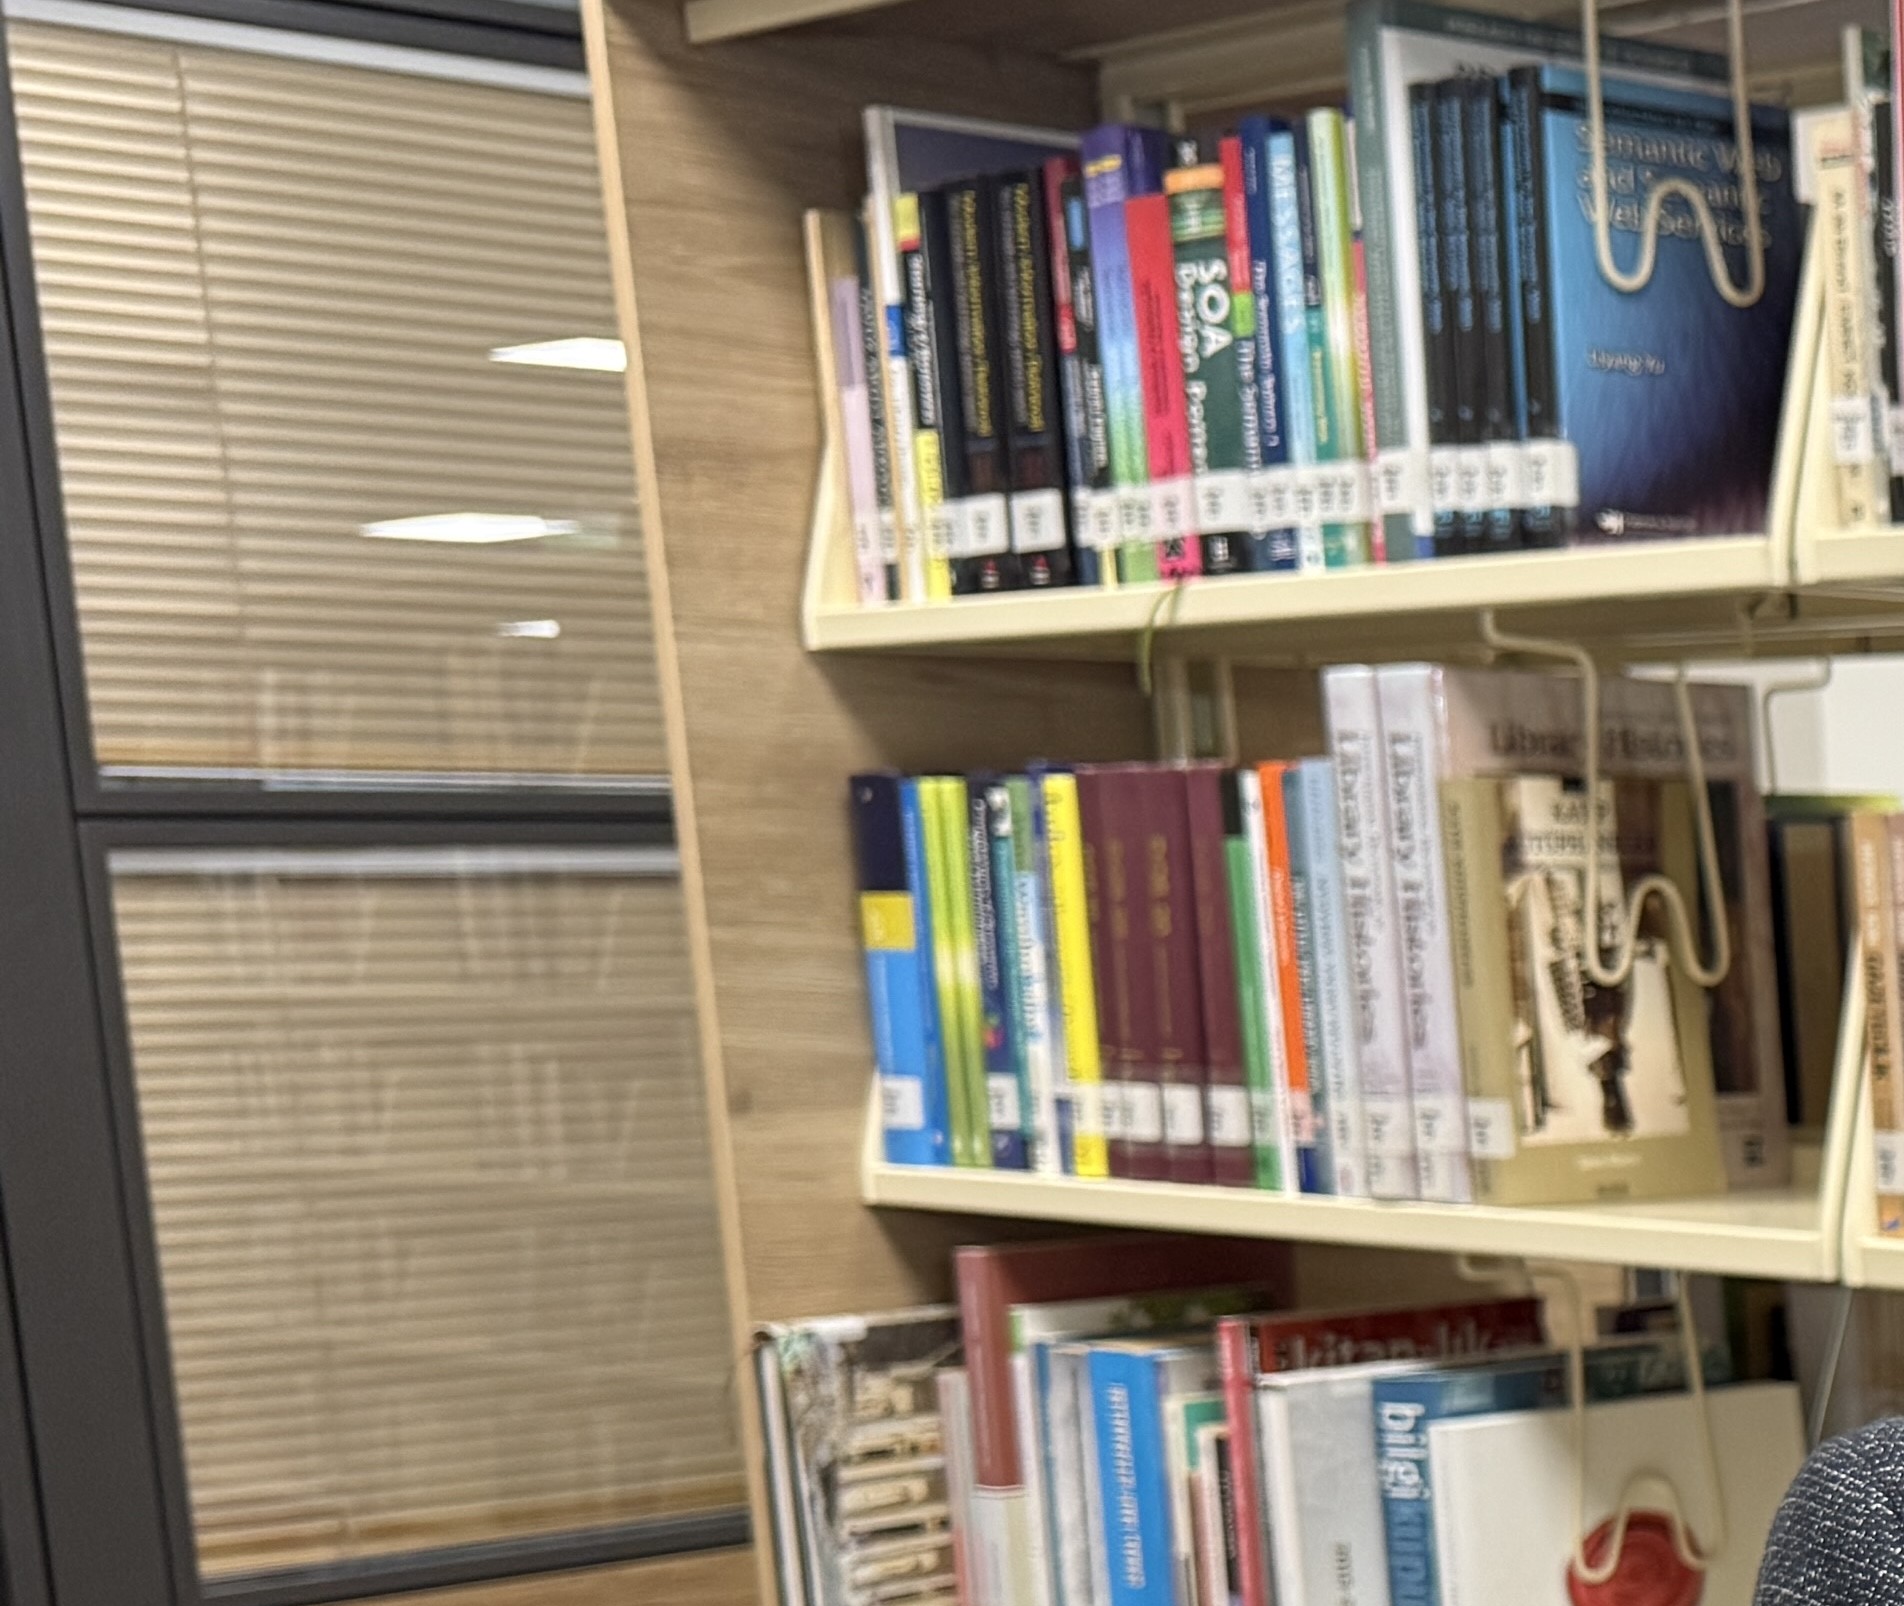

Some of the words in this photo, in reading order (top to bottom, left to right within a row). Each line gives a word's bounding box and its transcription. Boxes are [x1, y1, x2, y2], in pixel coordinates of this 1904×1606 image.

[1272, 157, 1300, 334] MESSAGES
[1198, 259, 1231, 357] SOA
[1380, 1401, 1430, 1500] bilgi
